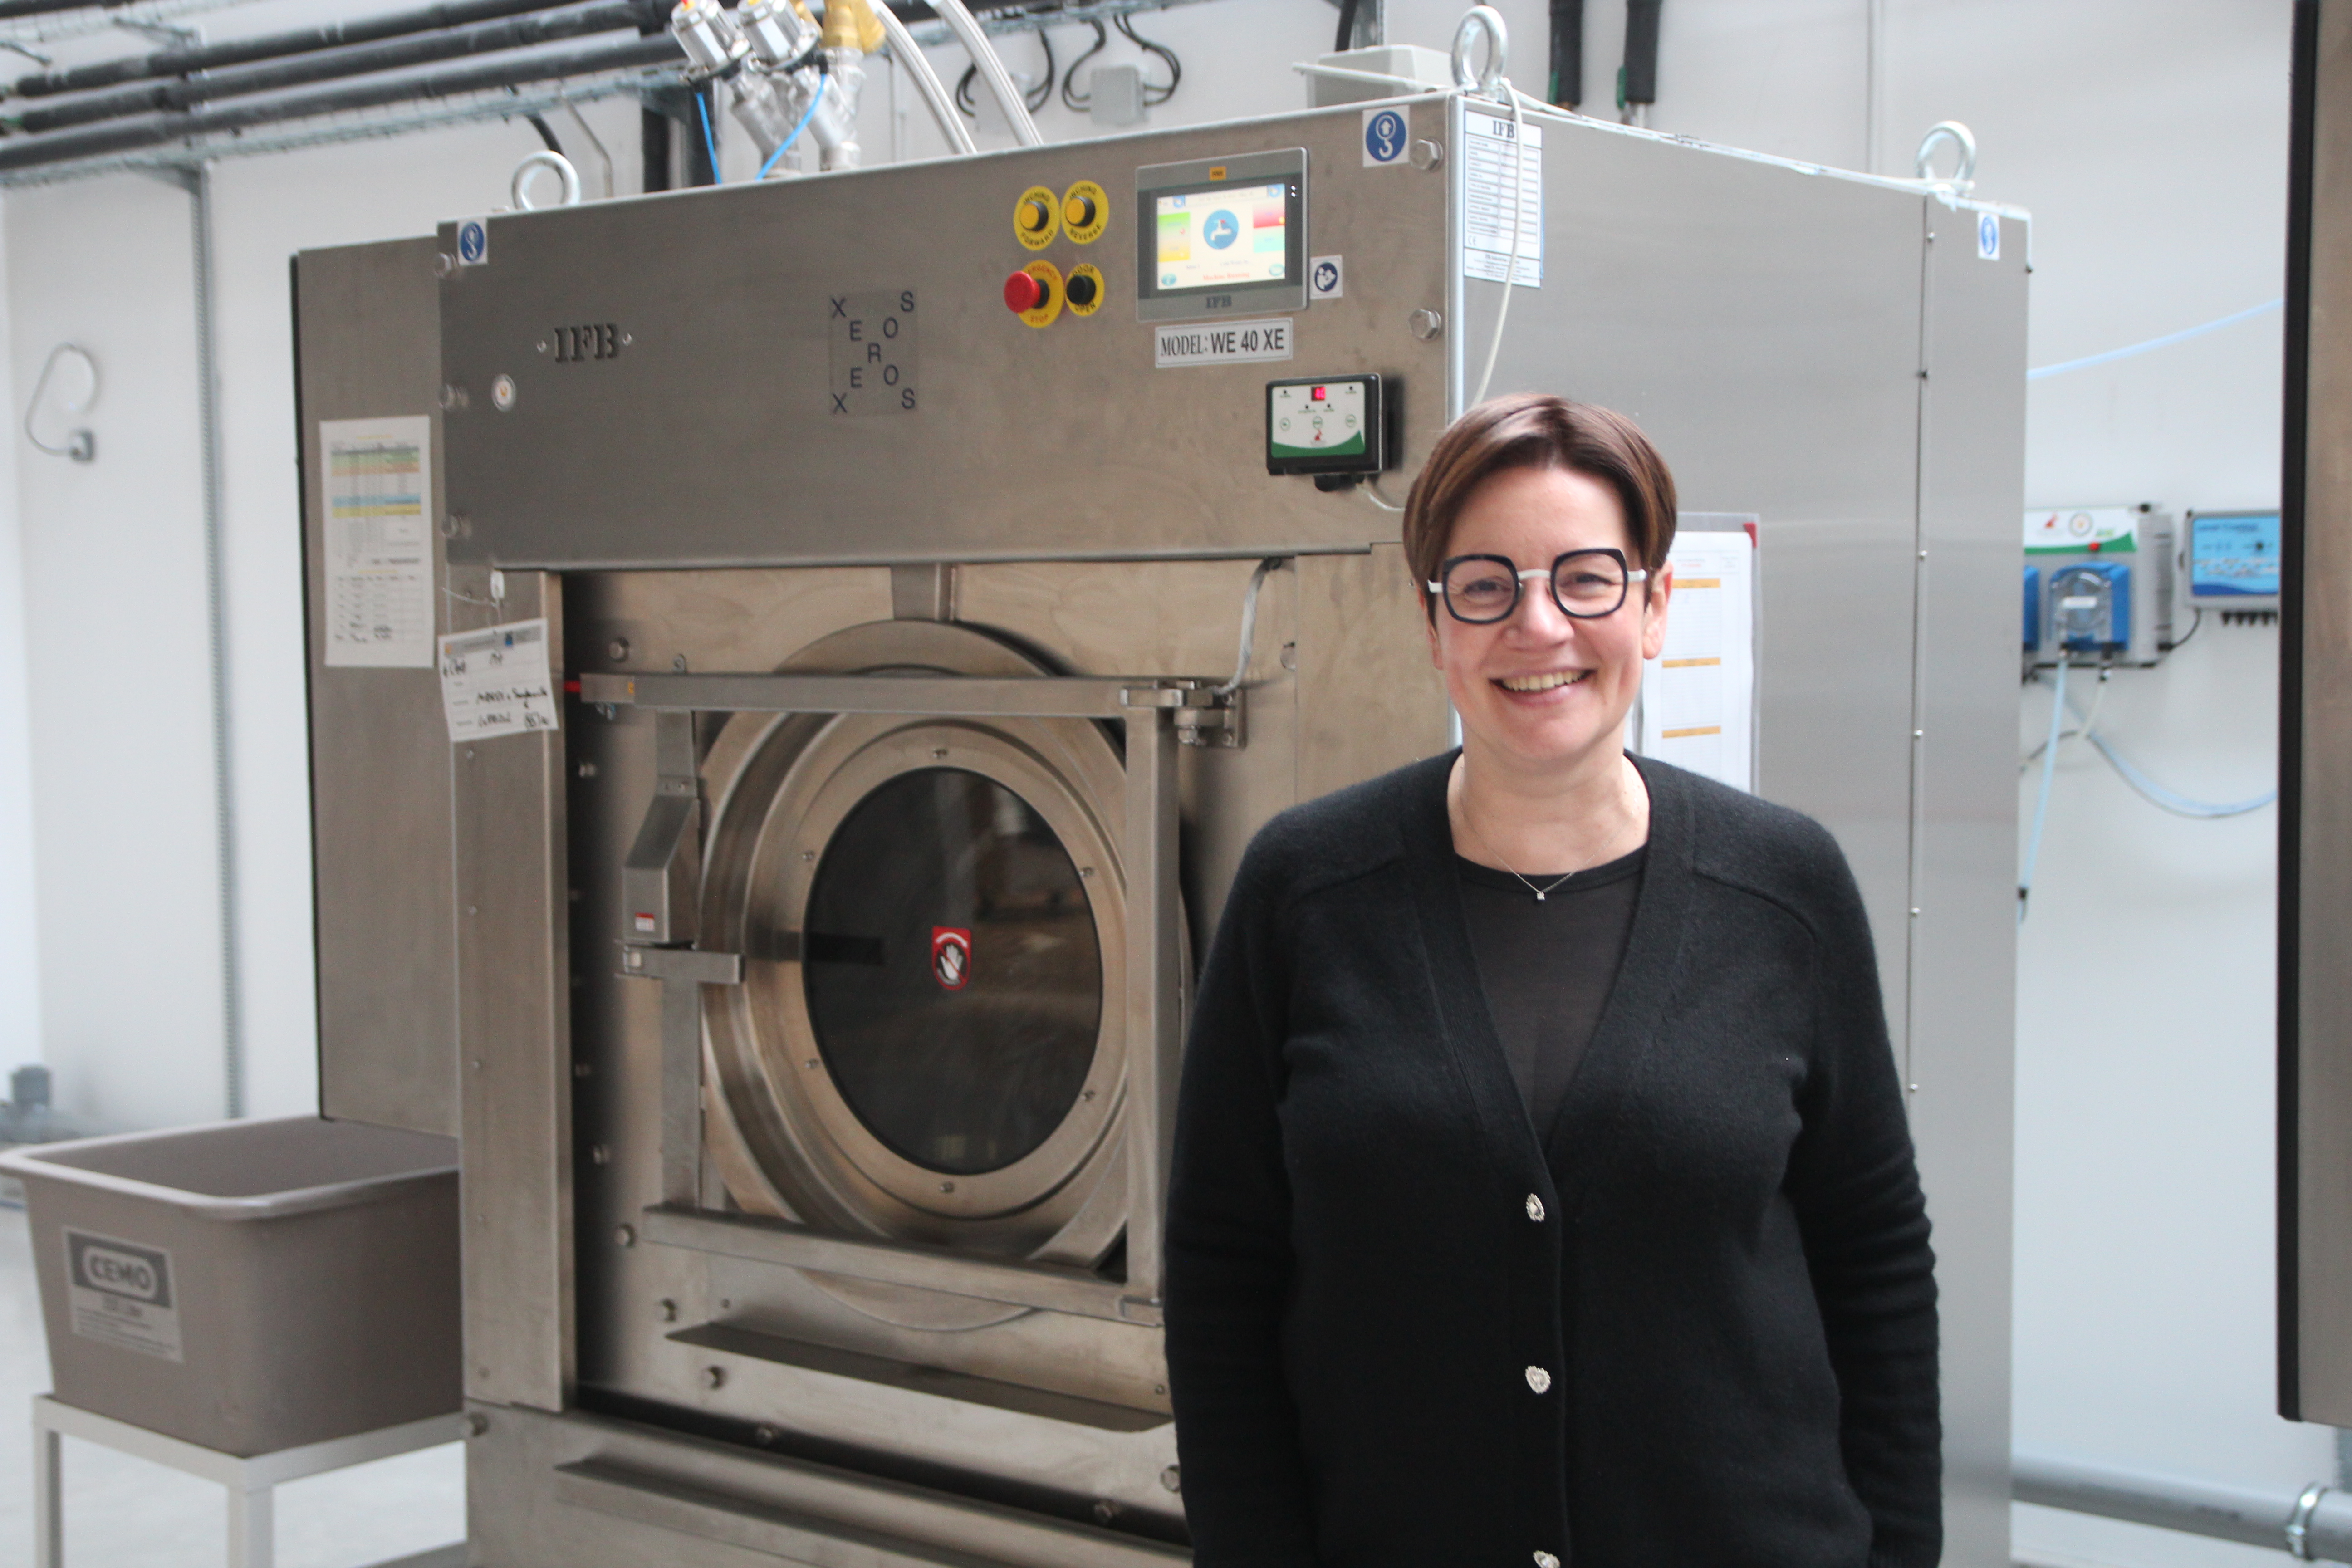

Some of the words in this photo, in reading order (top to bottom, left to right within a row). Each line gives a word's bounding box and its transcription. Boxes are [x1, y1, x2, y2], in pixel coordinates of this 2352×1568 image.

[1493, 120, 1515, 138] IFB
[1024, 191, 1051, 203] INCHING
[1070, 186, 1097, 197] INCHING
[1021, 229, 1054, 245] FORWARD
[1070, 223, 1102, 240] REVERSE
[1075, 301, 1097, 313] OPEN
[1206, 296, 1232, 308] IFB
[1030, 314, 1049, 323] STOP
[554, 323, 619, 363] IFB
[1160, 333, 1208, 356] MODEL:
[1211, 331, 1235, 353] WE
[1241, 330, 1258, 352] 40
[1264, 328, 1284, 350] XE
[91, 1255, 152, 1290] CEMO
